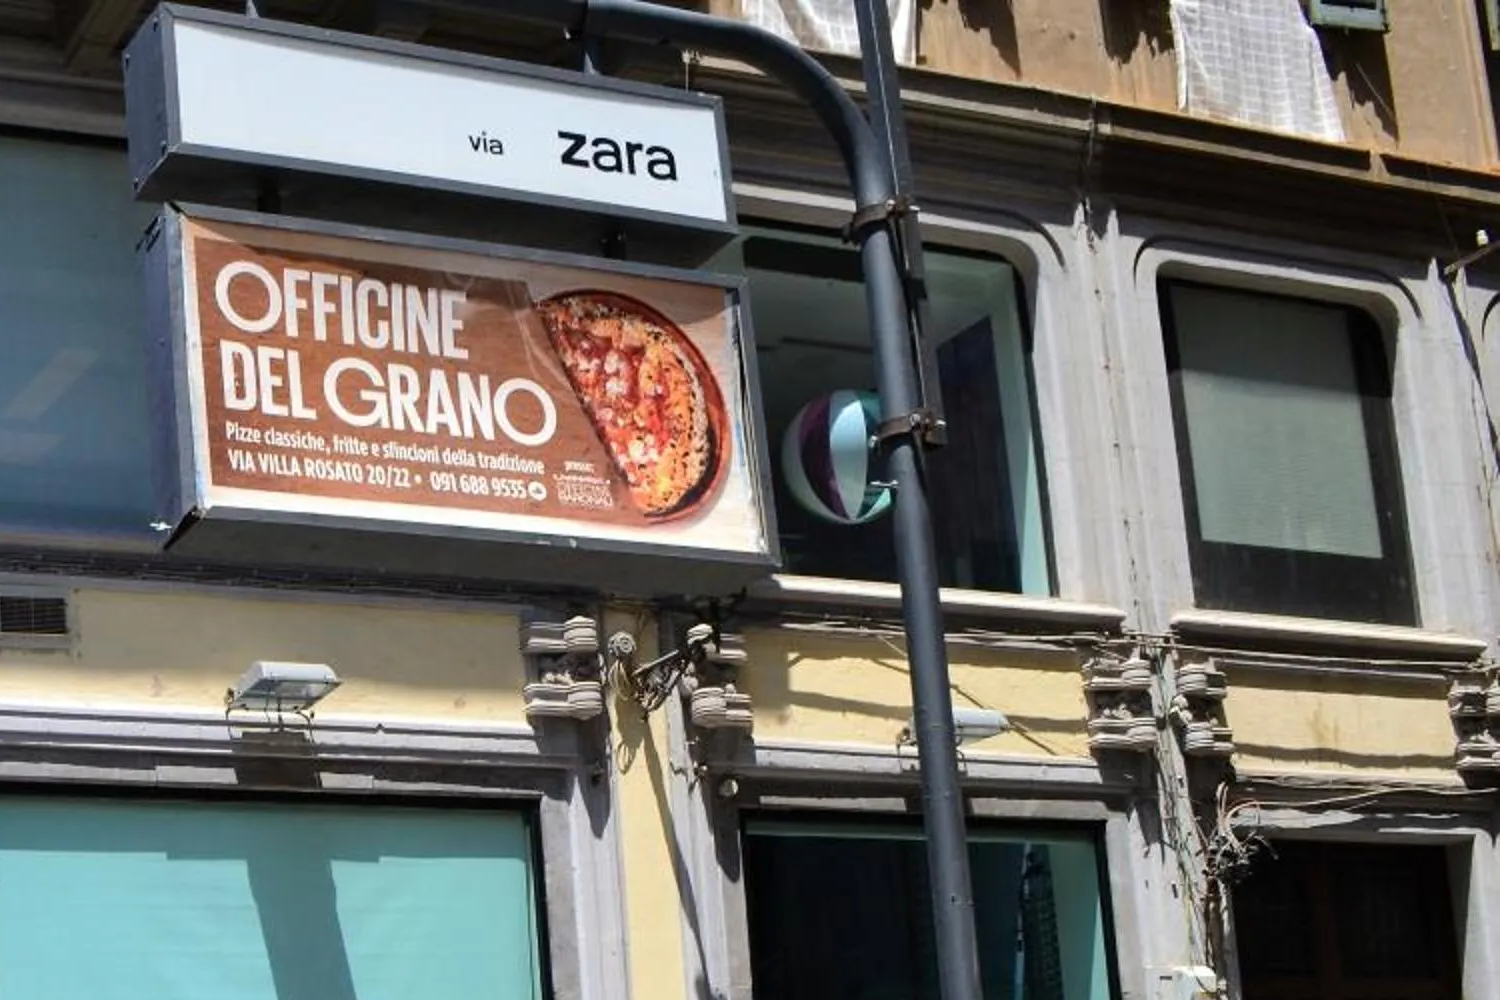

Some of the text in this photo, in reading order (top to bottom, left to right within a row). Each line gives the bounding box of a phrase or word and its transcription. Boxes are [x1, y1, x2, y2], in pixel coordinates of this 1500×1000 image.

[468, 130, 677, 181] via zara
[215, 260, 468, 360] OFFICINE
[219, 339, 557, 446] DEL GRANO
[225, 421, 261, 443] Pizze
[264, 427, 331, 455] classiche,
[334, 435, 368, 457] fritte
[371, 443, 381, 457] e
[442, 447, 476, 468] della
[477, 451, 545, 475] tradizione
[228, 448, 256, 473] VIA
[257, 452, 300, 477] VILLA
[303, 459, 363, 483] ROSATO
[367, 465, 412, 488] 20/22
[429, 471, 458, 493] 091
